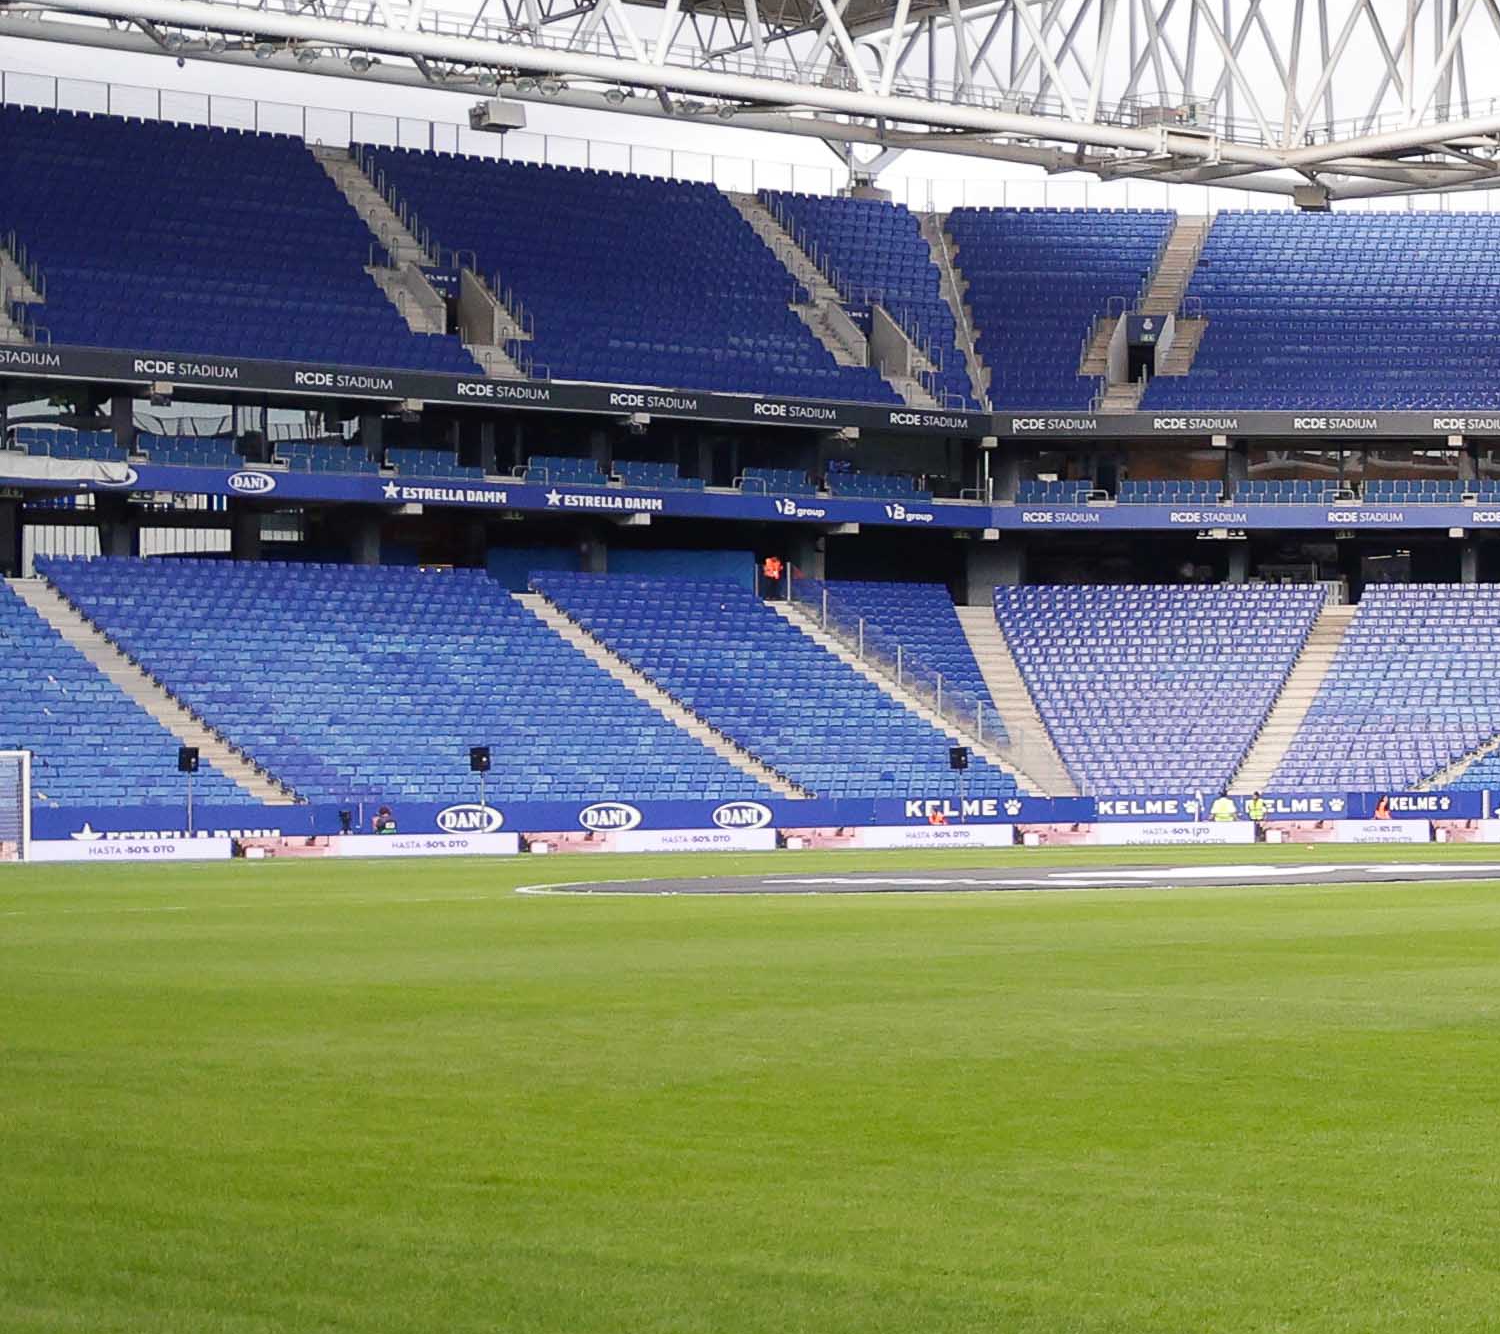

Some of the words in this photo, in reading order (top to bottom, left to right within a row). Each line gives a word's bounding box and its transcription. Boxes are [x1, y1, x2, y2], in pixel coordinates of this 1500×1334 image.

[0, 350, 60, 366] STADIUM
[134, 359, 175, 375] RCDE
[179, 363, 238, 379] STADIUM
[1012, 418, 1046, 434] RCDE
[1047, 418, 1097, 430] STADIUM
[234, 476, 264, 489] DANI
[402, 487, 465, 502] ESTRELLA
[466, 490, 507, 503] DAMM
[564, 494, 623, 509] ESTRELLA
[624, 497, 663, 510] DAMM
[1098, 800, 1178, 815] KELME
[1262, 798, 1324, 813] ELME
[1389, 796, 1438, 810] KELME
[445, 808, 489, 830] DANI
[587, 807, 627, 826] DANI
[721, 804, 759, 824] DANI
